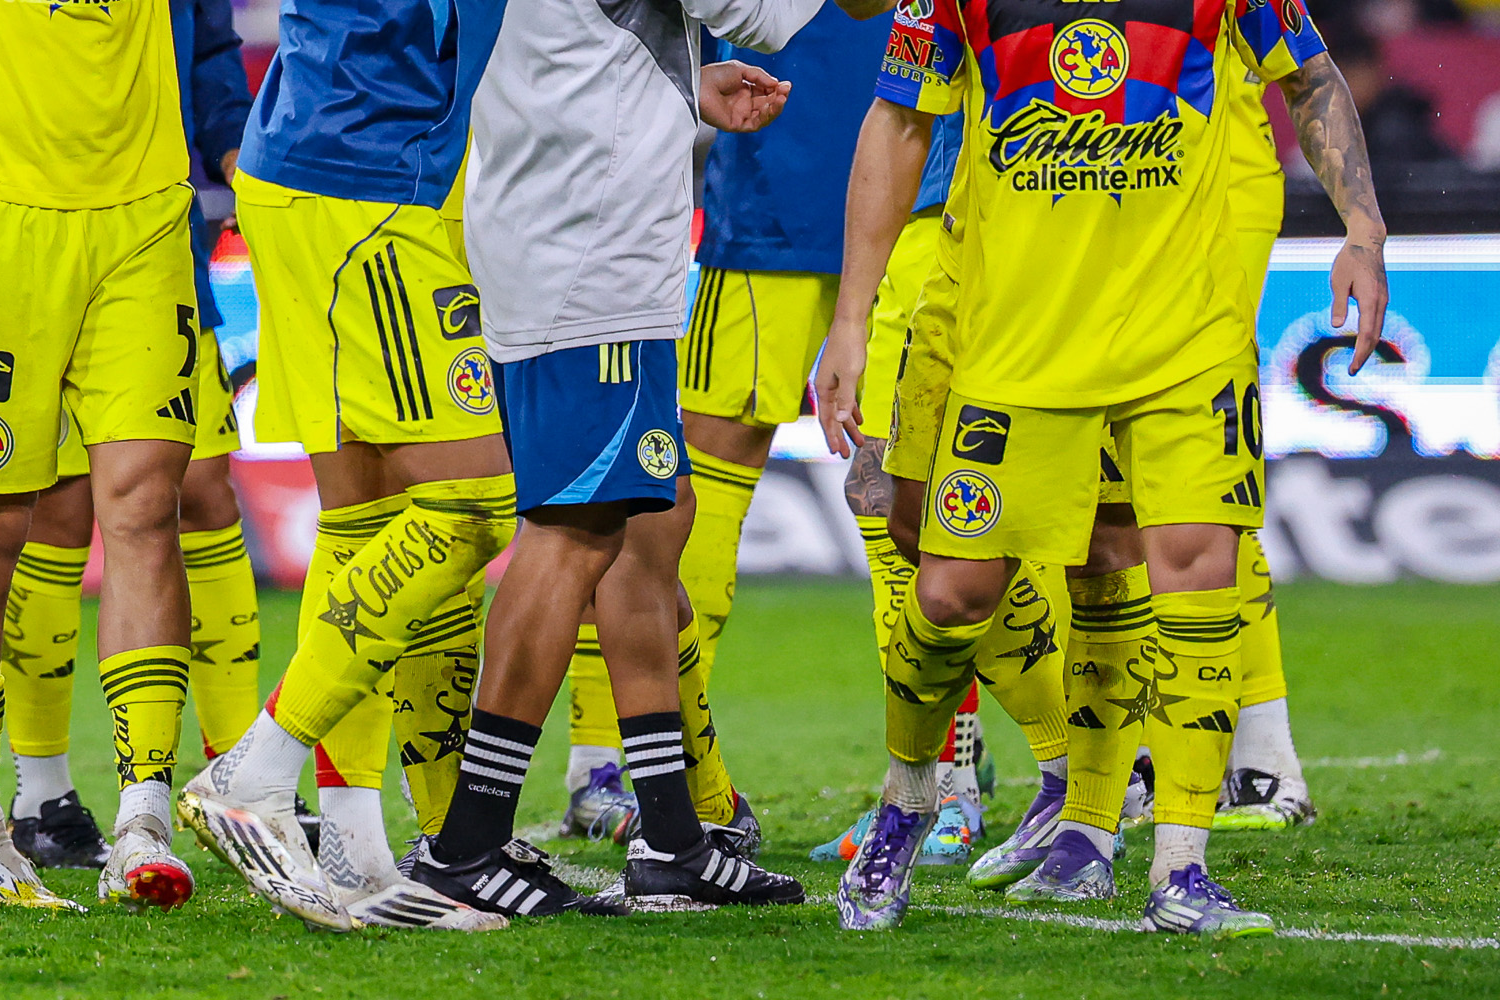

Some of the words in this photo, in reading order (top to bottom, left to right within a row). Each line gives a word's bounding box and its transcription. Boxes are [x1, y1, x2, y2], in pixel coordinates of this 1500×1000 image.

[986, 102, 1184, 173] Caliente
[1012, 162, 1180, 192] caliente.mx
[176, 303, 198, 378] 5
[1211, 377, 1264, 461] 10
[1071, 661, 1100, 677] CA
[1197, 665, 1232, 682] CA
[147, 748, 176, 763] CA
[468, 783, 511, 798] adidas
